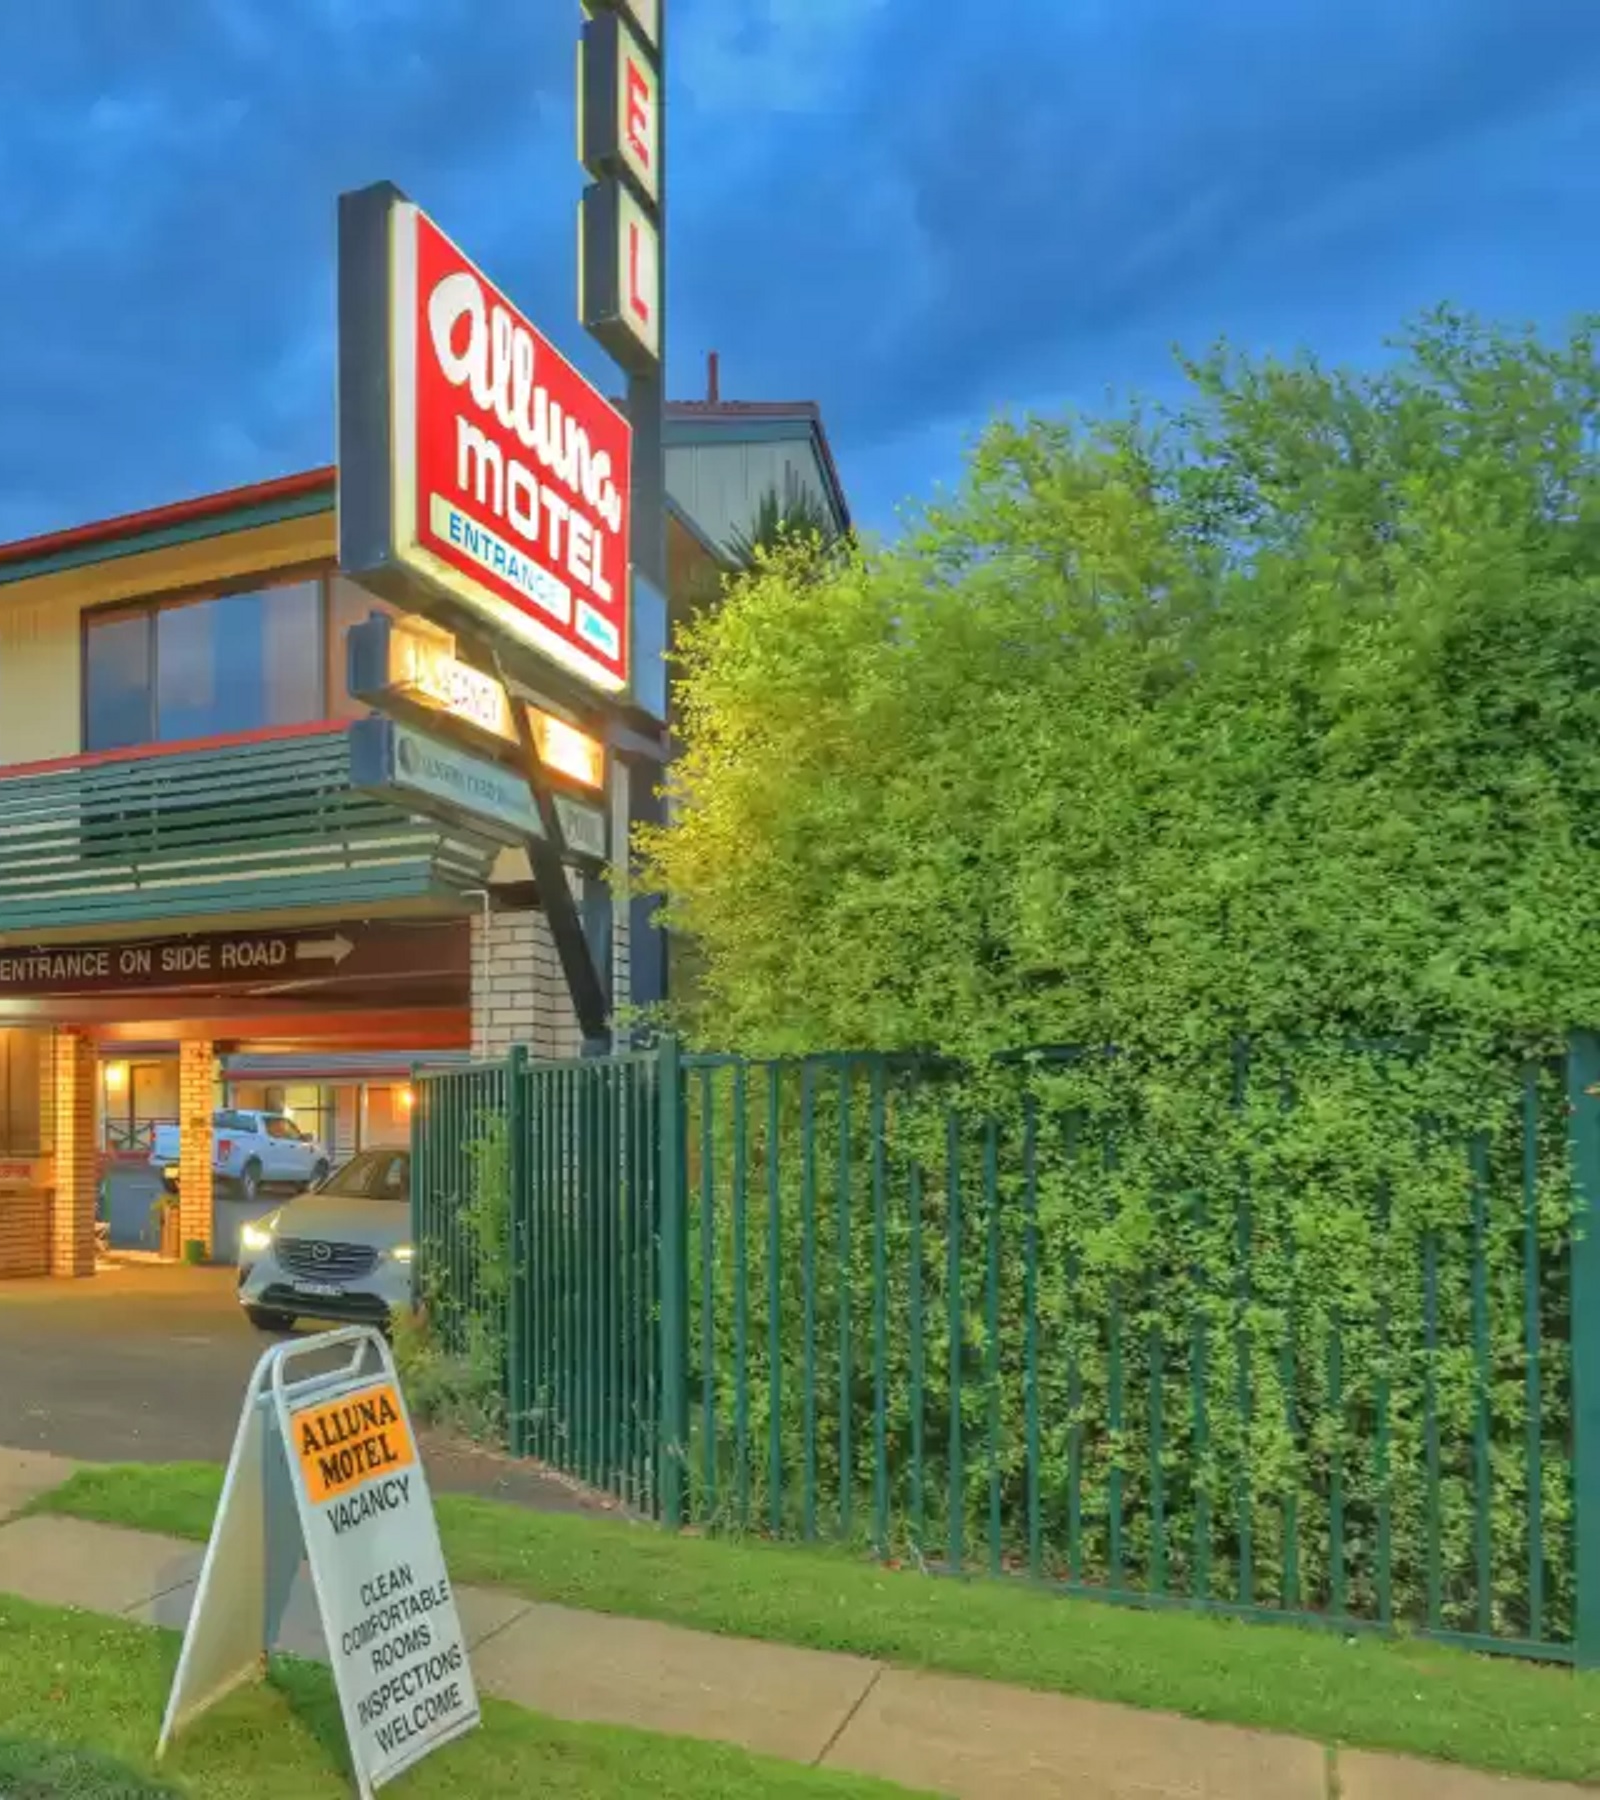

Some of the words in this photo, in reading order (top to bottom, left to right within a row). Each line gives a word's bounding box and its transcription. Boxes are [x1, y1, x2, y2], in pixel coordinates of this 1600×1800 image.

[0, 951, 110, 981] ENTRANCE
[119, 949, 151, 974] ON
[161, 945, 211, 971] SIDE
[221, 939, 286, 968] ROAD
[301, 1394, 398, 1456] ALLUNA
[319, 1433, 399, 1489] MOTEL
[327, 1475, 411, 1535] VACANCY
[360, 1563, 414, 1607] CLEAN
[341, 1578, 450, 1656] COMFORTABLE
[372, 1624, 432, 1674] ROOMS
[357, 1645, 463, 1726] INSPECTIONS
[375, 1682, 464, 1756] WELCOME
